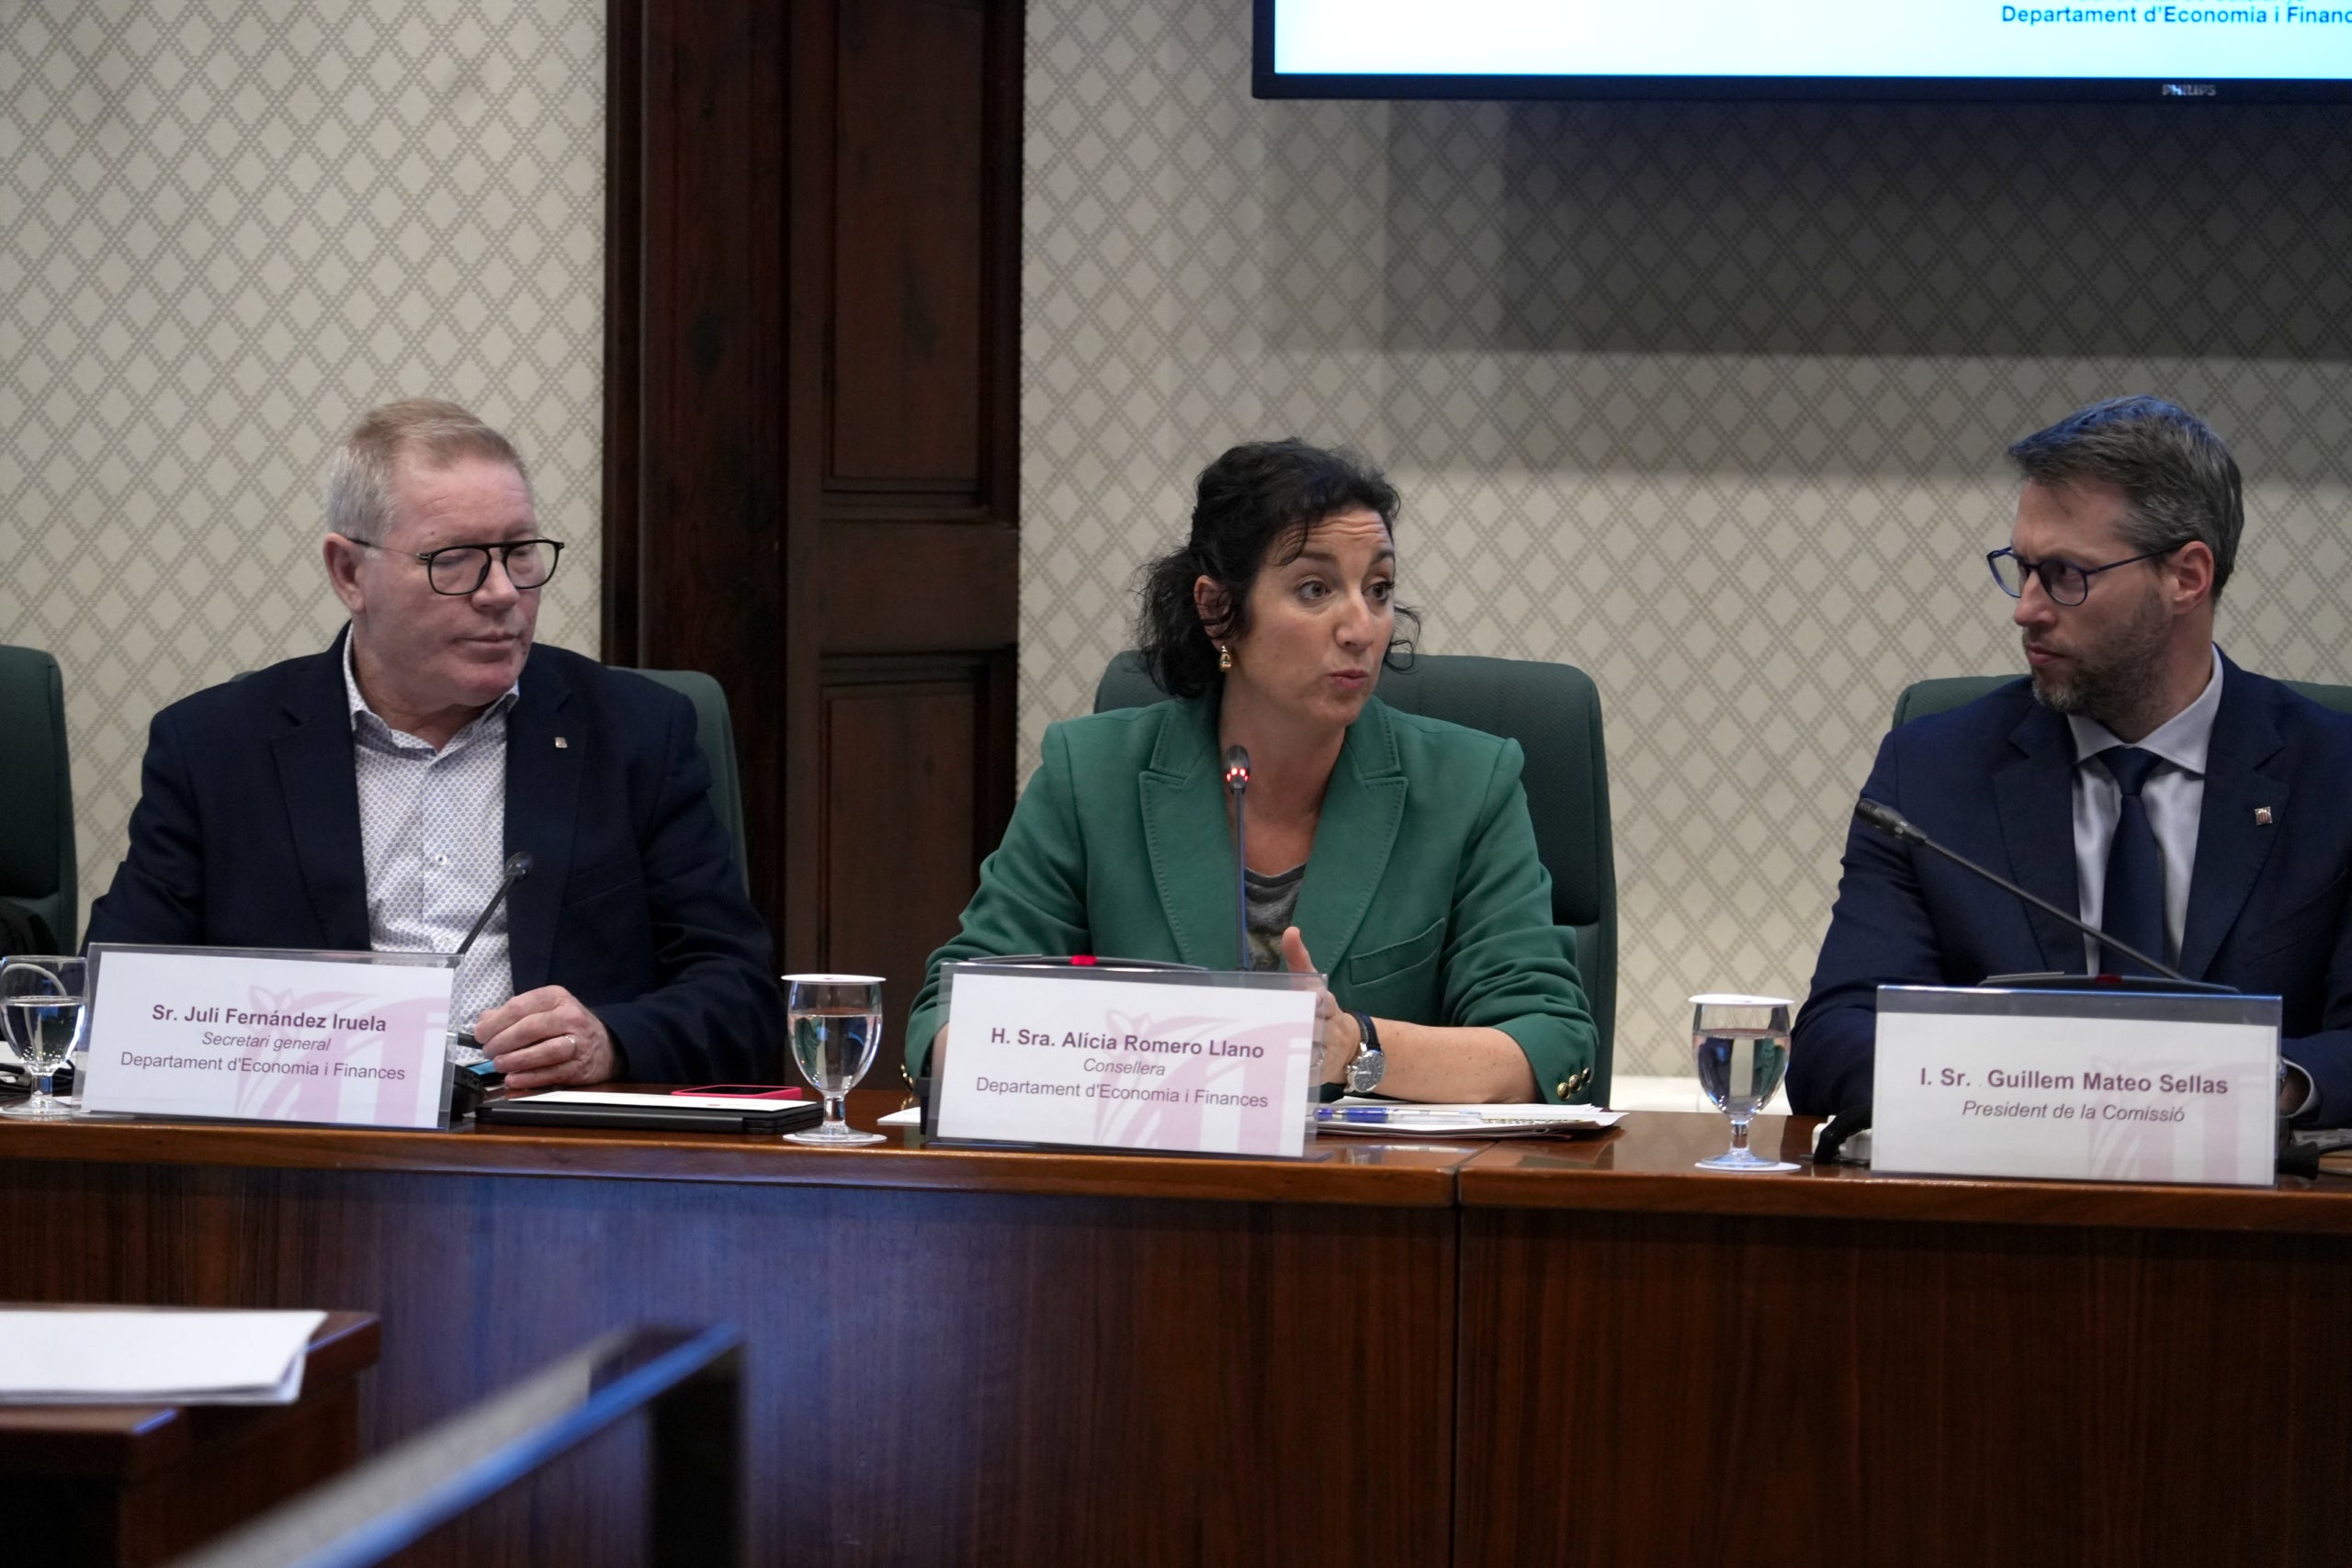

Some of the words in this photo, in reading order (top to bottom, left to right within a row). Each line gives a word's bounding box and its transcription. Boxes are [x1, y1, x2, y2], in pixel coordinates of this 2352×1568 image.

[2002, 6, 2137, 26] Departament
[2143, 6, 2267, 24] d'Economia
[2274, 6, 2278, 23] i
[2162, 84, 2216, 96] PHILIPS
[152, 1004, 178, 1021] Sr.
[184, 1006, 220, 1024] Juli
[225, 1008, 326, 1029] Fernández
[333, 1013, 387, 1032] Iruela
[202, 1032, 270, 1048] Secretari
[273, 1037, 331, 1052] general
[990, 1027, 1011, 1044] H.
[1017, 1029, 1055, 1047] Sra.
[1062, 1032, 1117, 1051] Alícia
[1125, 1035, 1203, 1055] Romero
[1209, 1039, 1265, 1059] Llano
[120, 1051, 222, 1071] Departament
[227, 1057, 319, 1076] d'Economia
[324, 1063, 329, 1076] i
[334, 1063, 405, 1080] Finances
[1083, 1058, 1166, 1077] Consellera
[976, 1077, 1080, 1098] Departament
[1085, 1084, 1180, 1103] d'Economia
[1184, 1089, 1189, 1103] i
[1194, 1089, 1269, 1108] Finances
[1920, 1067, 1932, 1086] I.
[1940, 1068, 1971, 1087] Sr.
[1987, 1069, 2074, 1089] Guillem
[2083, 1072, 2152, 1091] Mateo
[2159, 1074, 2228, 1094] Sellas
[1962, 1100, 2048, 1119] President
[2052, 1102, 2075, 1119] de
[2080, 1104, 2096, 1120] la
[2102, 1104, 2185, 1122] Comissió
